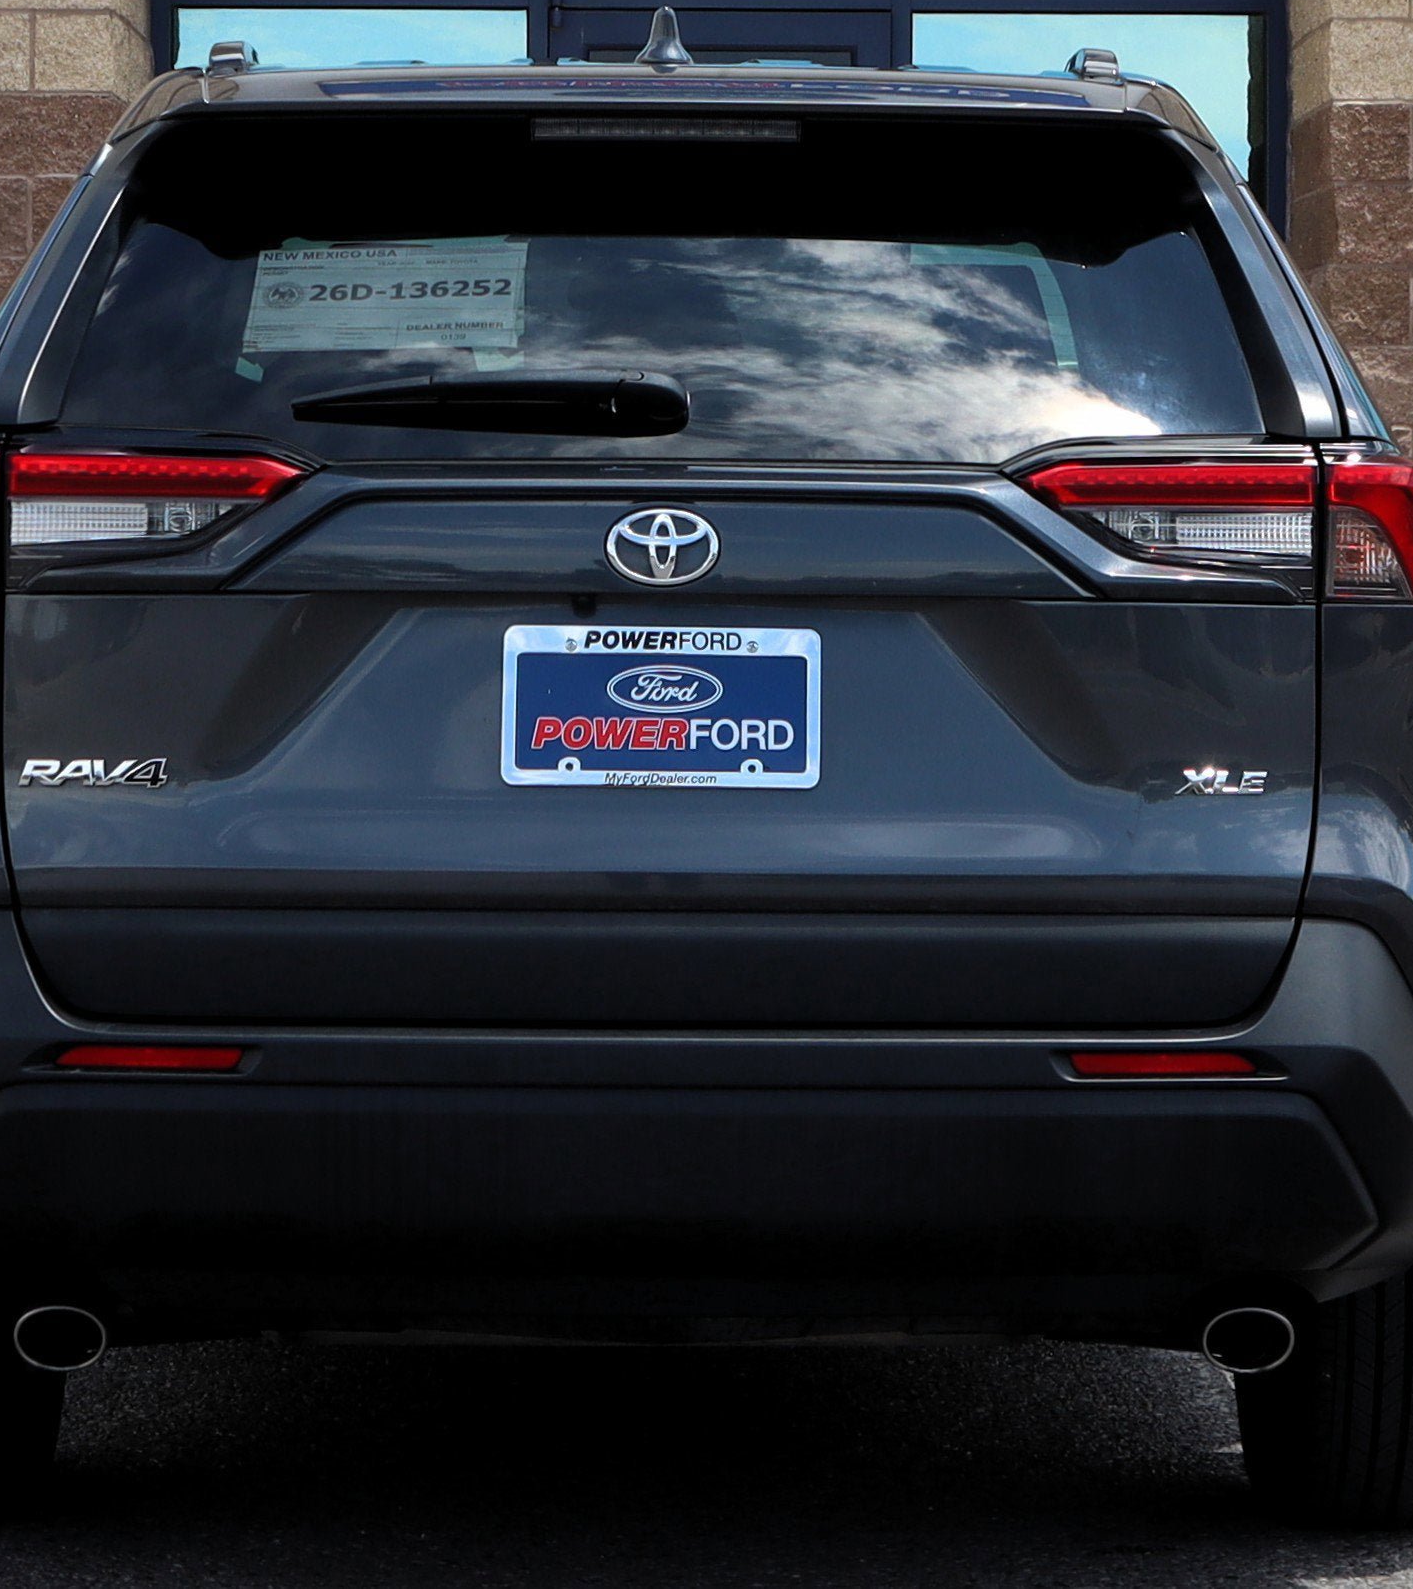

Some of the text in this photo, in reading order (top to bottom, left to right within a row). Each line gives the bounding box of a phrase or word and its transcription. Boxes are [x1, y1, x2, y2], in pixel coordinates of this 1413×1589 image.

[263, 249, 397, 261] NEW MEXICO USA
[309, 279, 512, 302] 26D-136252
[406, 321, 504, 331] DEALER NUMBER
[584, 630, 742, 651] POWERFORD
[630, 674, 698, 702] Ford
[531, 716, 794, 751] POWERFORD
[18, 758, 167, 788] RAV4
[604, 772, 718, 787] MyFordDealer.com
[1174, 768, 1268, 795] XLE
